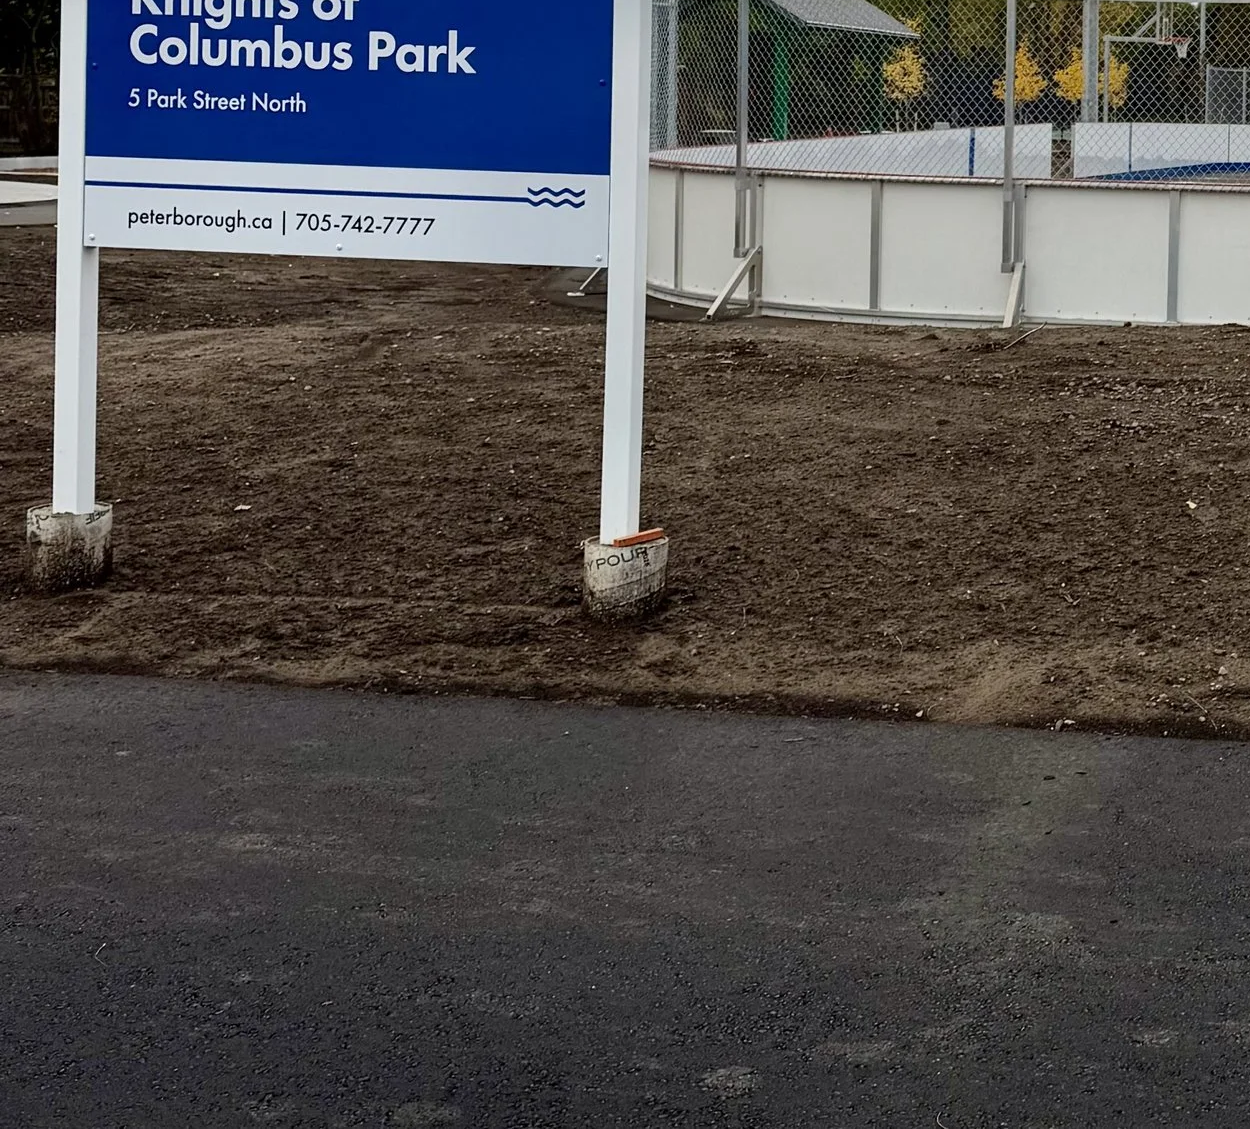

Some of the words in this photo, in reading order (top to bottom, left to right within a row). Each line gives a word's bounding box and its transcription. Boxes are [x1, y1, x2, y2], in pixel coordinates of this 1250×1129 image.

[129, 22, 353, 71] Columbus
[368, 29, 477, 74] Park
[127, 88, 140, 108] 5
[147, 87, 188, 109] Park
[192, 89, 247, 112] Street
[252, 91, 307, 113] North
[128, 206, 273, 234] peterborough.ca
[295, 212, 436, 236] 705-742-7777
